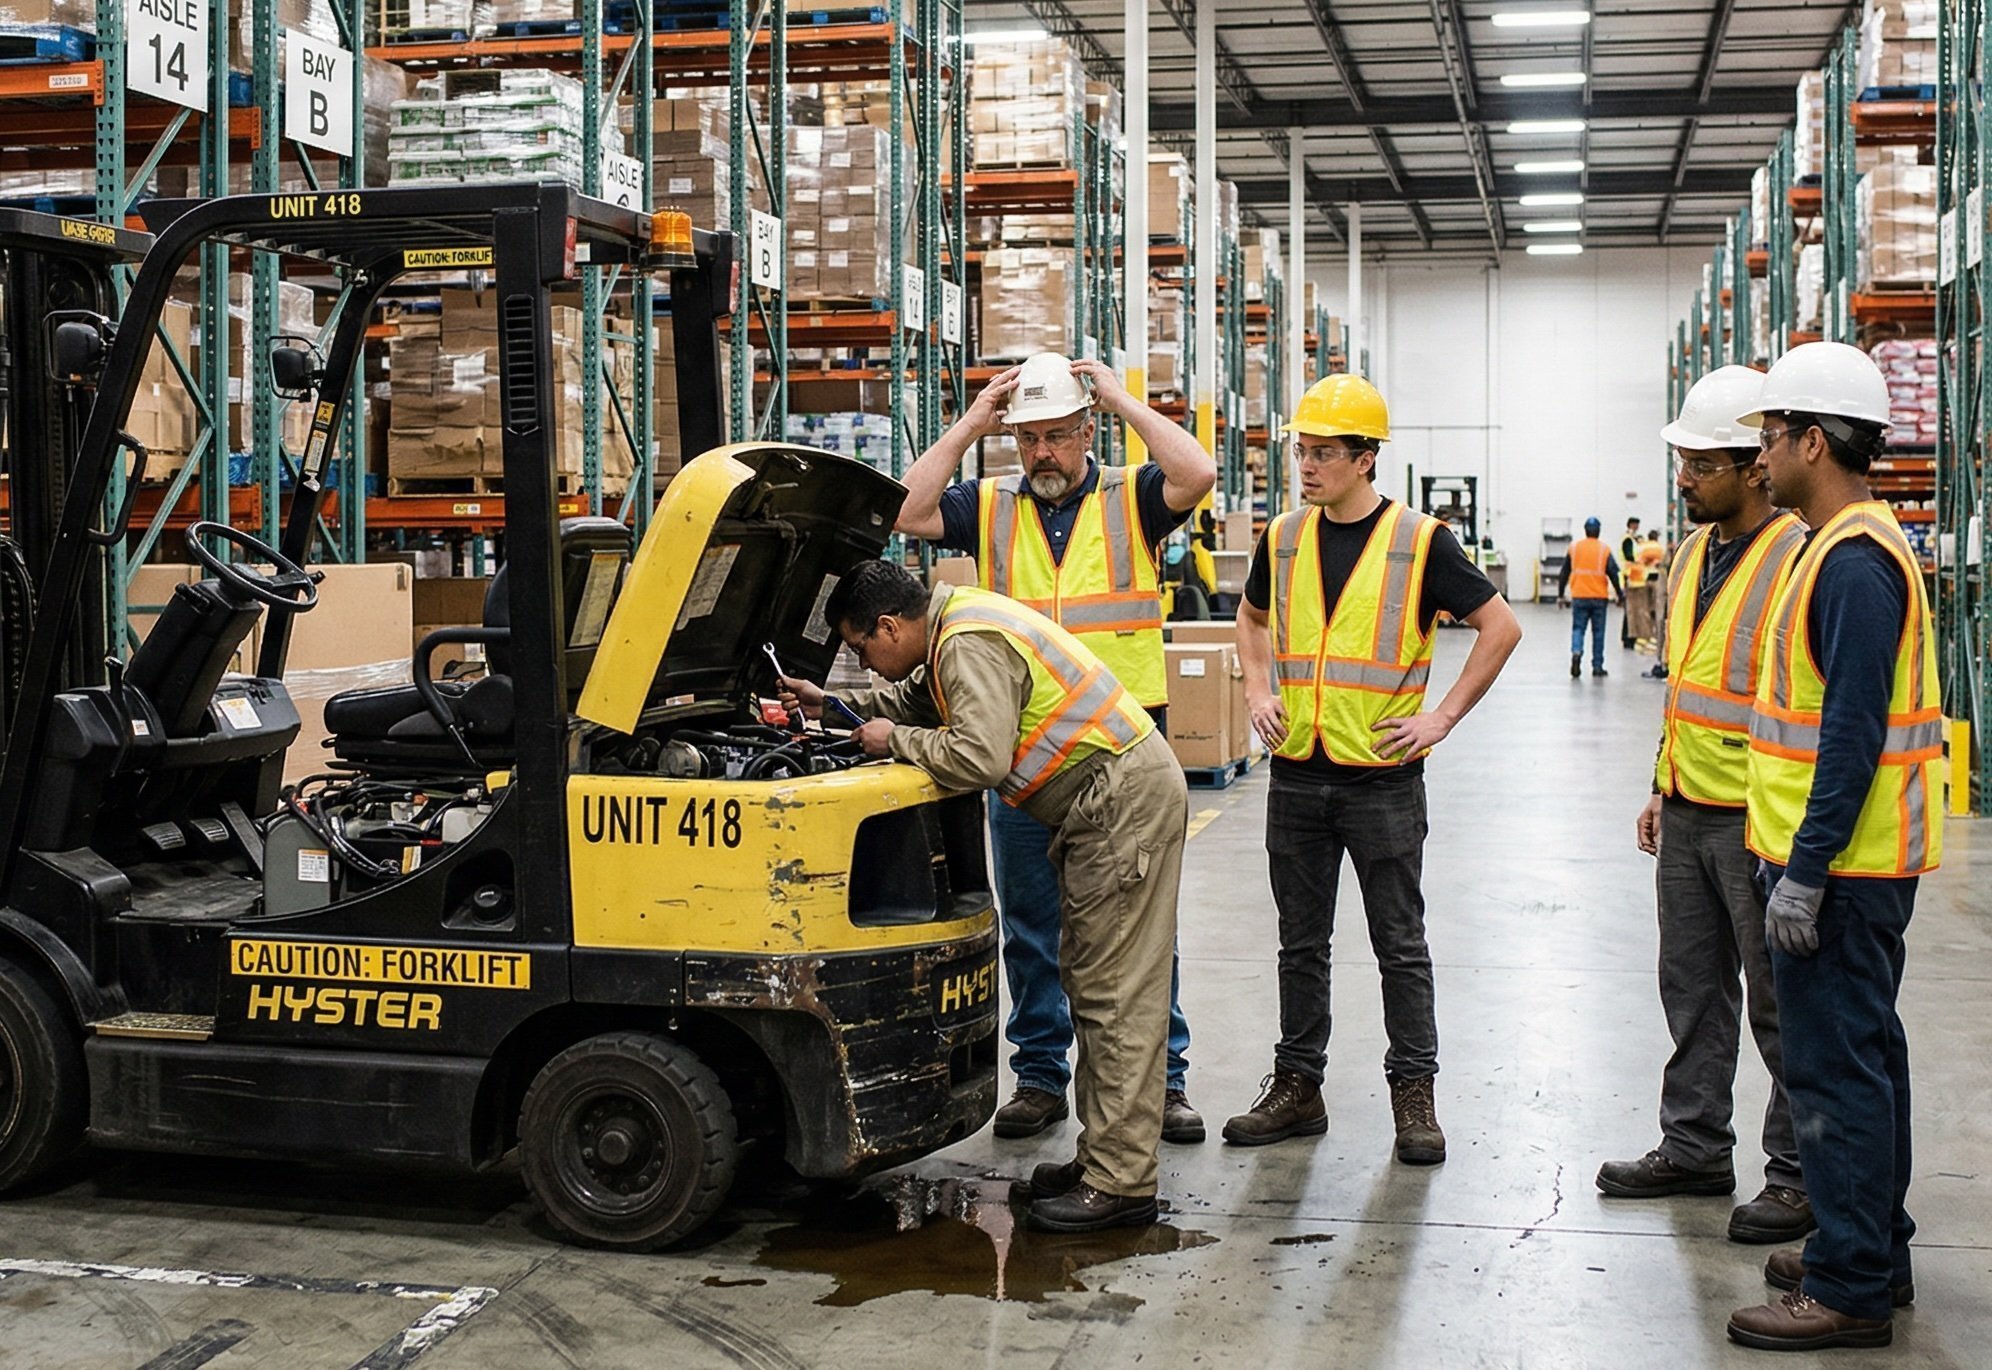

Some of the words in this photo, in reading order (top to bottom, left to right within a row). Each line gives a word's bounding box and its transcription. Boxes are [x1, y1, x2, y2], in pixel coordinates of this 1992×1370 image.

[148, 33, 189, 92] 14
[302, 47, 336, 83] BAY
[310, 89, 329, 137] B
[607, 160, 638, 190] AISLE
[270, 195, 318, 218] UNIT
[324, 193, 361, 216] 418
[762, 248, 771, 279] B
[583, 795, 668, 845] UNIT
[678, 797, 742, 849] 418
[238, 942, 370, 978] CAUTION:
[382, 949, 522, 985] FORKLIFT
[247, 984, 443, 1030] HYSTER
